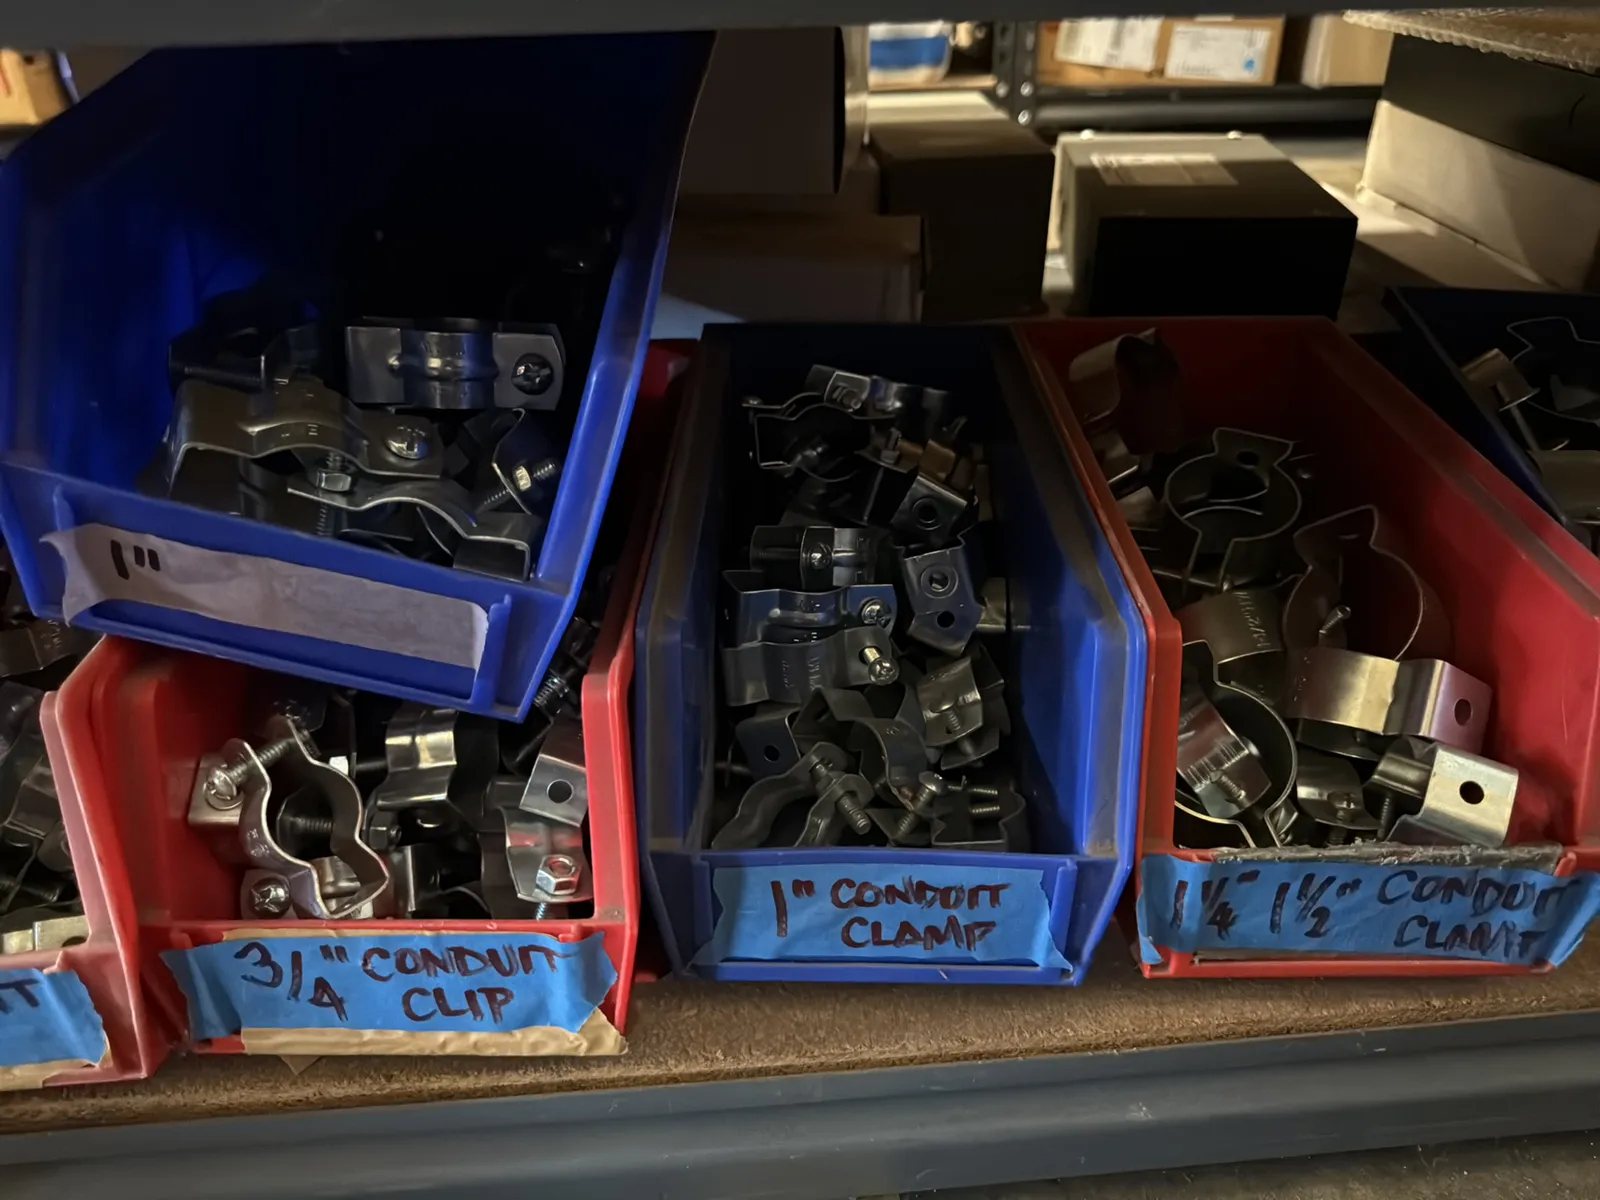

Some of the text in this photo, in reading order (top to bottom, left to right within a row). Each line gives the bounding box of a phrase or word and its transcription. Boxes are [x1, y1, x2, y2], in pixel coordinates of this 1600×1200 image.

[770, 875, 1013, 938] 1" CONDUIT
[840, 915, 996, 952] CLAMP
[362, 944, 574, 982] CONDUIT
[402, 987, 515, 1024] CLIP
